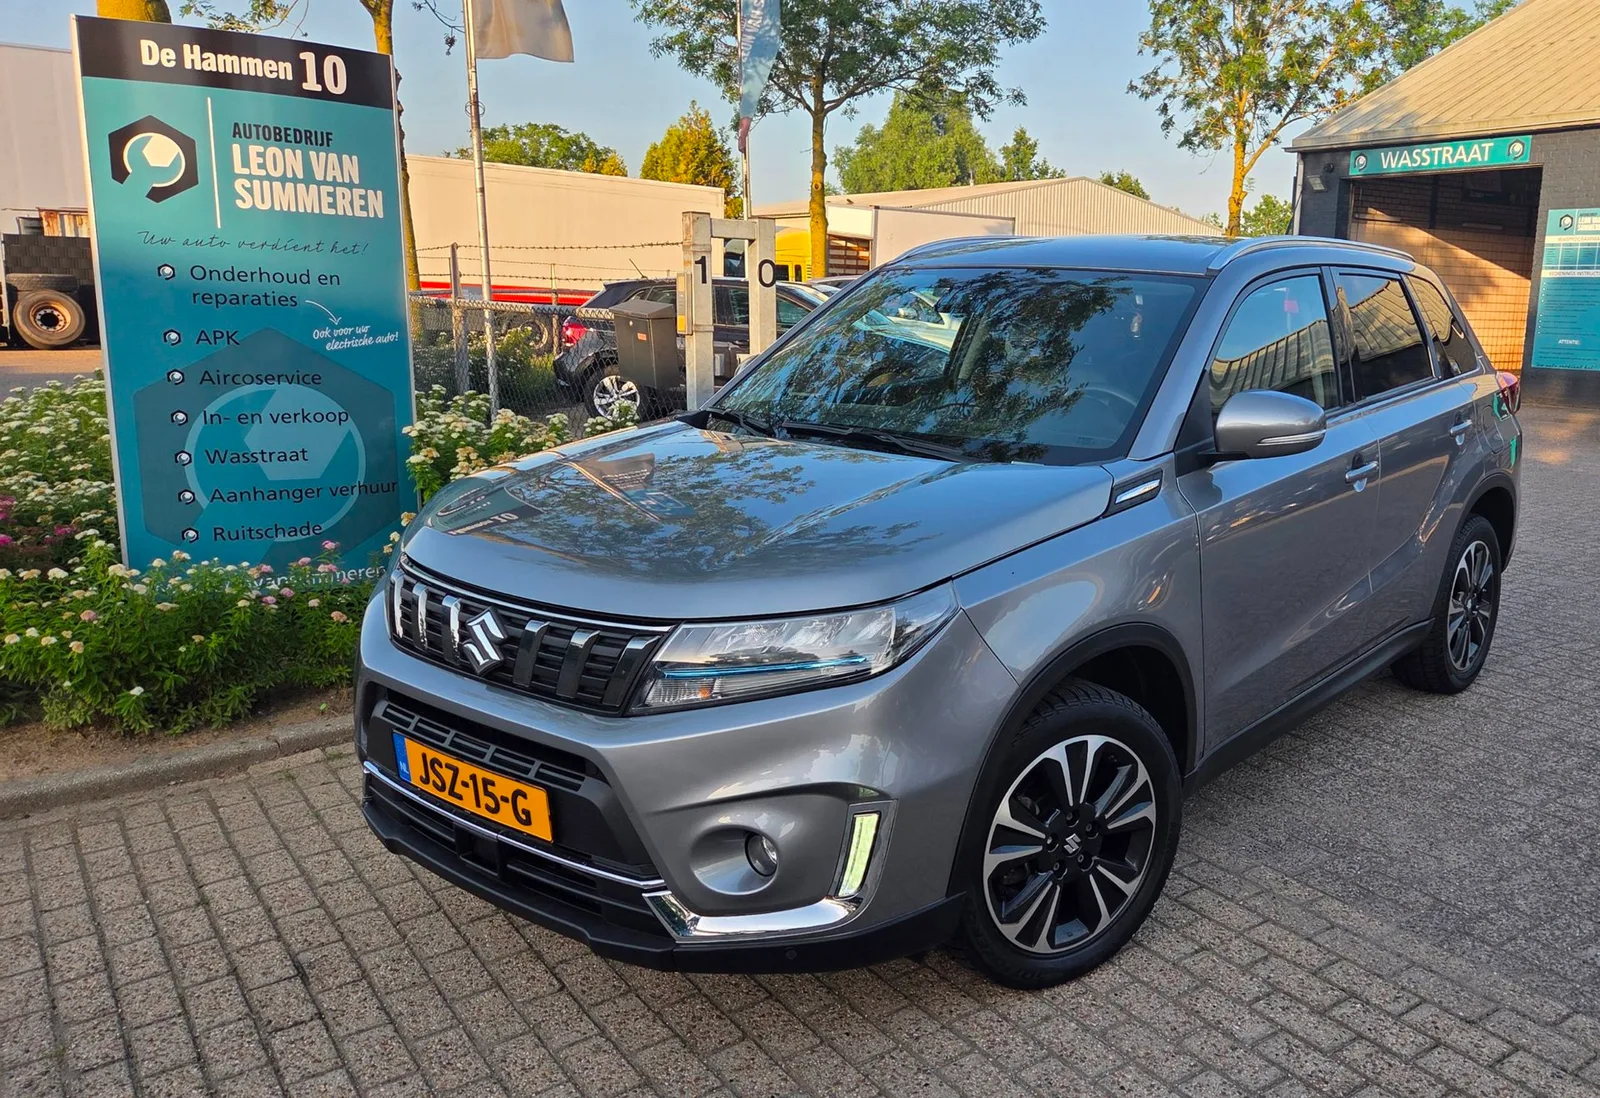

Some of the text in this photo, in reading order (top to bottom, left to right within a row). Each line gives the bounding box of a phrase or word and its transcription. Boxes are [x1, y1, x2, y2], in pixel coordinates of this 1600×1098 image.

[140, 39, 347, 95] De Hammen 10
[232, 122, 333, 148] AUTOBEDRIJF
[232, 143, 359, 184] LEON VAN
[1381, 142, 1494, 169] WASSTRAAT
[234, 178, 384, 218] SUMMEREN
[137, 231, 369, 255] Uw auto verdient het!
[190, 264, 340, 286] Onderhoud en
[695, 255, 776, 288] 1 0
[192, 290, 298, 308] reparaties
[195, 329, 240, 346] APK
[313, 325, 371, 339] Ook voor uw
[326, 331, 399, 351] electrische auto!
[199, 369, 322, 386] Aircoservice
[202, 407, 349, 426] In- en verkoop
[204, 447, 309, 465] Wasstraat
[210, 480, 398, 504] Aanhanger verhuur
[213, 521, 322, 542] Ruitschade
[419, 752, 532, 826] JSZ-15-G
